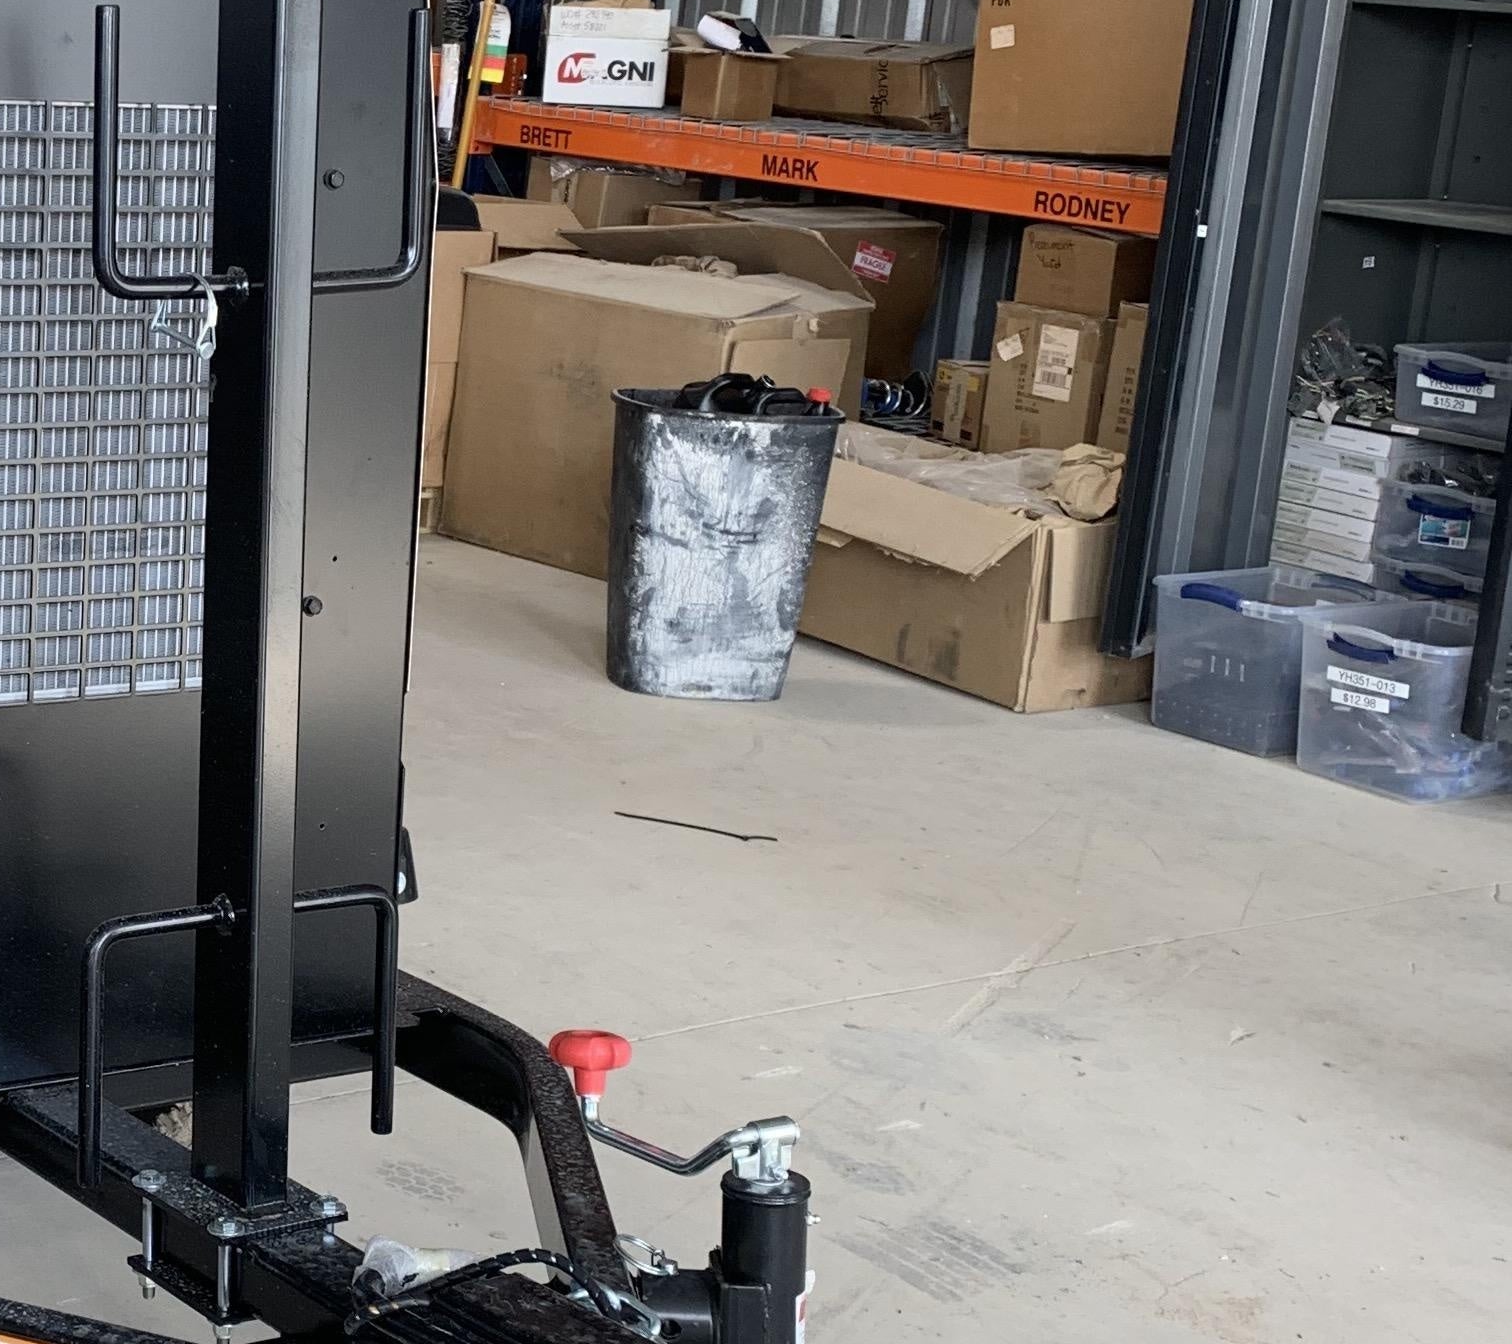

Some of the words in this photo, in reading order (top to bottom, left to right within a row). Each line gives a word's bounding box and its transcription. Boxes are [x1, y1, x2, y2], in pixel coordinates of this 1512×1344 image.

[520, 124, 572, 150] BRETT
[761, 154, 819, 182] MARK
[1034, 190, 1131, 225] RODNEY
[1338, 670, 1396, 693] YH351-013
